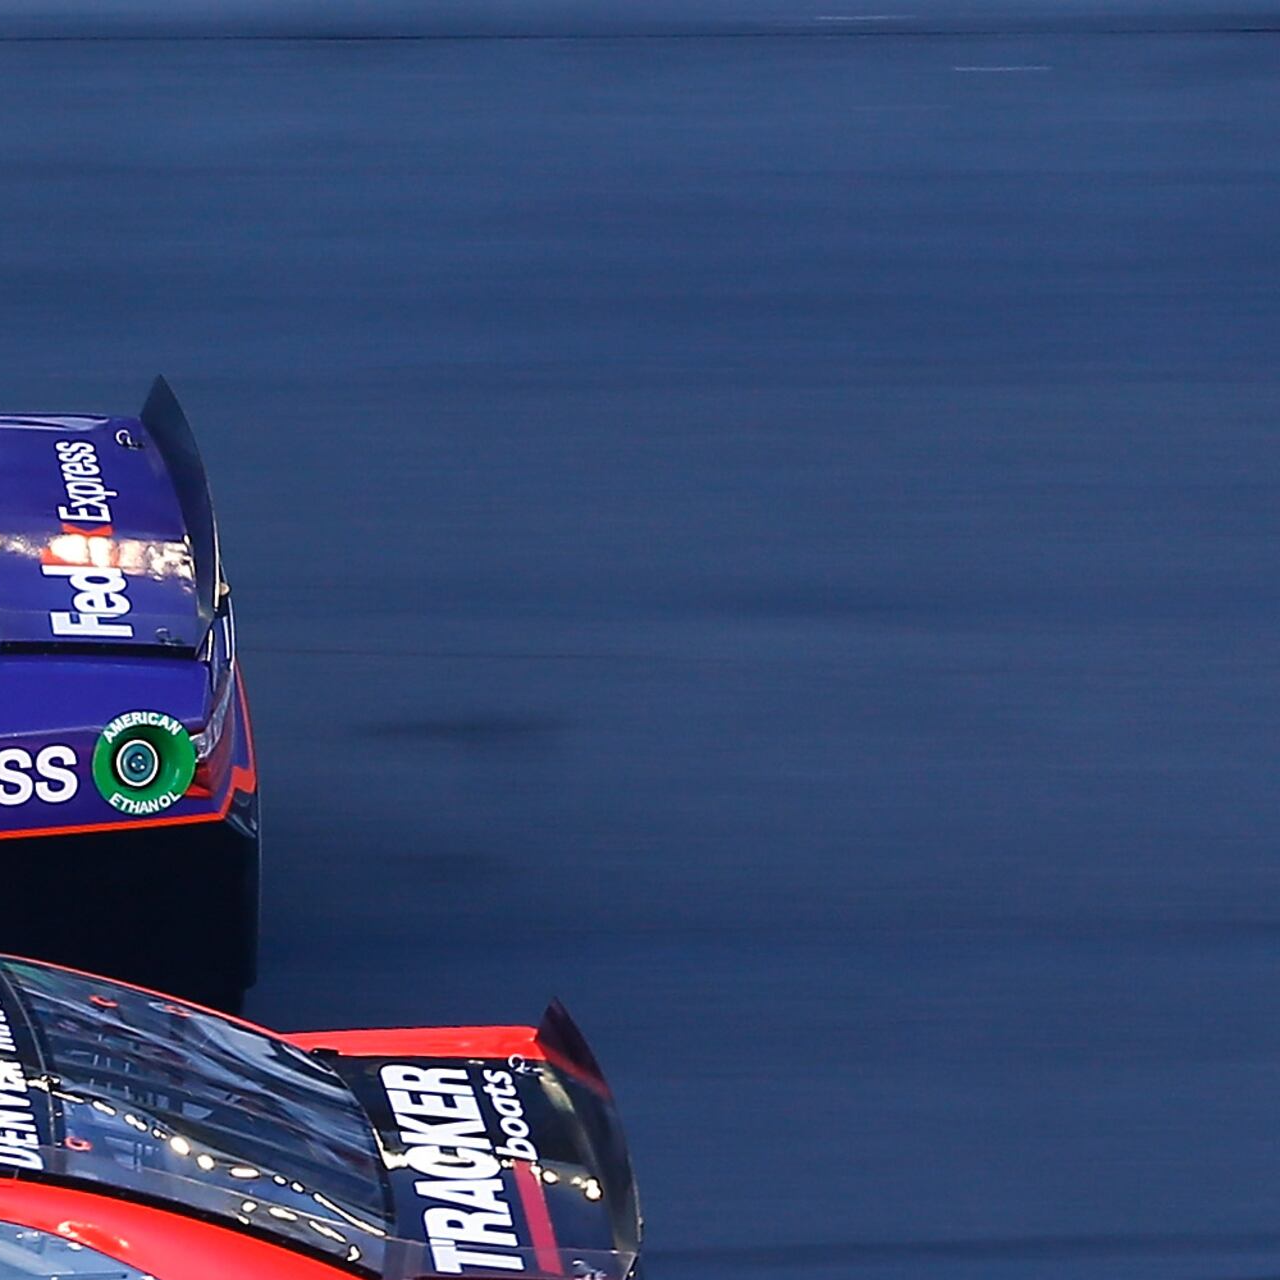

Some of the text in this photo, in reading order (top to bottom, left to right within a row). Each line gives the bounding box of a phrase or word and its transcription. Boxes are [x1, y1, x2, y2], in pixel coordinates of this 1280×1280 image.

[55, 440, 119, 523] Express
[103, 711, 183, 744] AMERICAN
[108, 791, 181, 815] ETHANOL
[482, 1068, 539, 1161] boats
[379, 1063, 525, 1275] TRACKER
